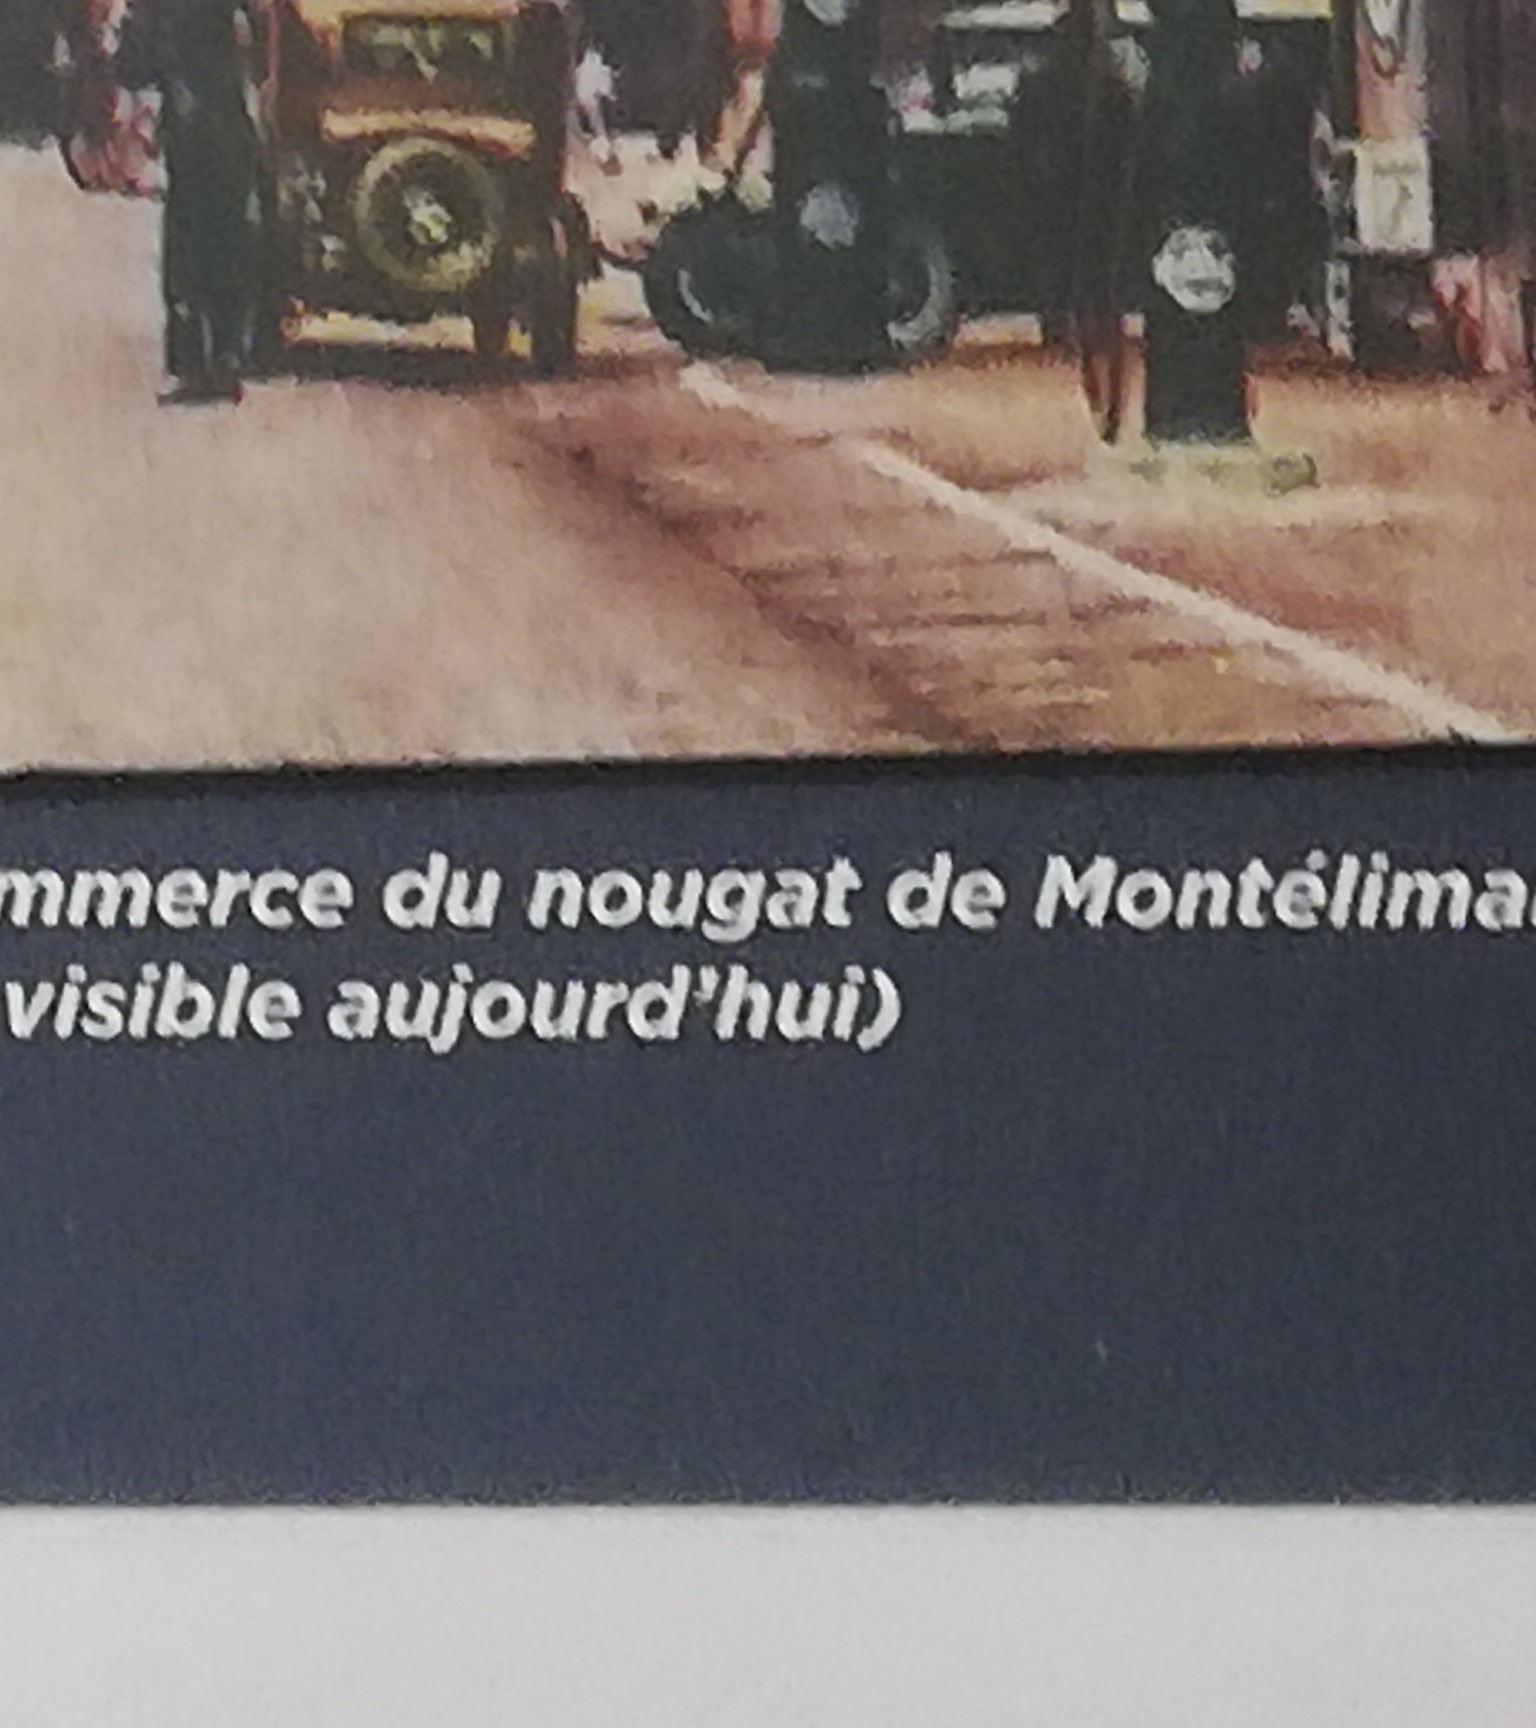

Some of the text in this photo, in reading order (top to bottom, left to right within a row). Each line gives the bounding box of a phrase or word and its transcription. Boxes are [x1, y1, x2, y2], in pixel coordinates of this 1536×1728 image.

[382, 851, 502, 929] du
[527, 857, 863, 943] nougat
[887, 851, 1006, 929] de
[1034, 849, 1536, 930] Montélima
[4, 961, 302, 1040] visible
[327, 963, 901, 1054] aujourd'hui)
